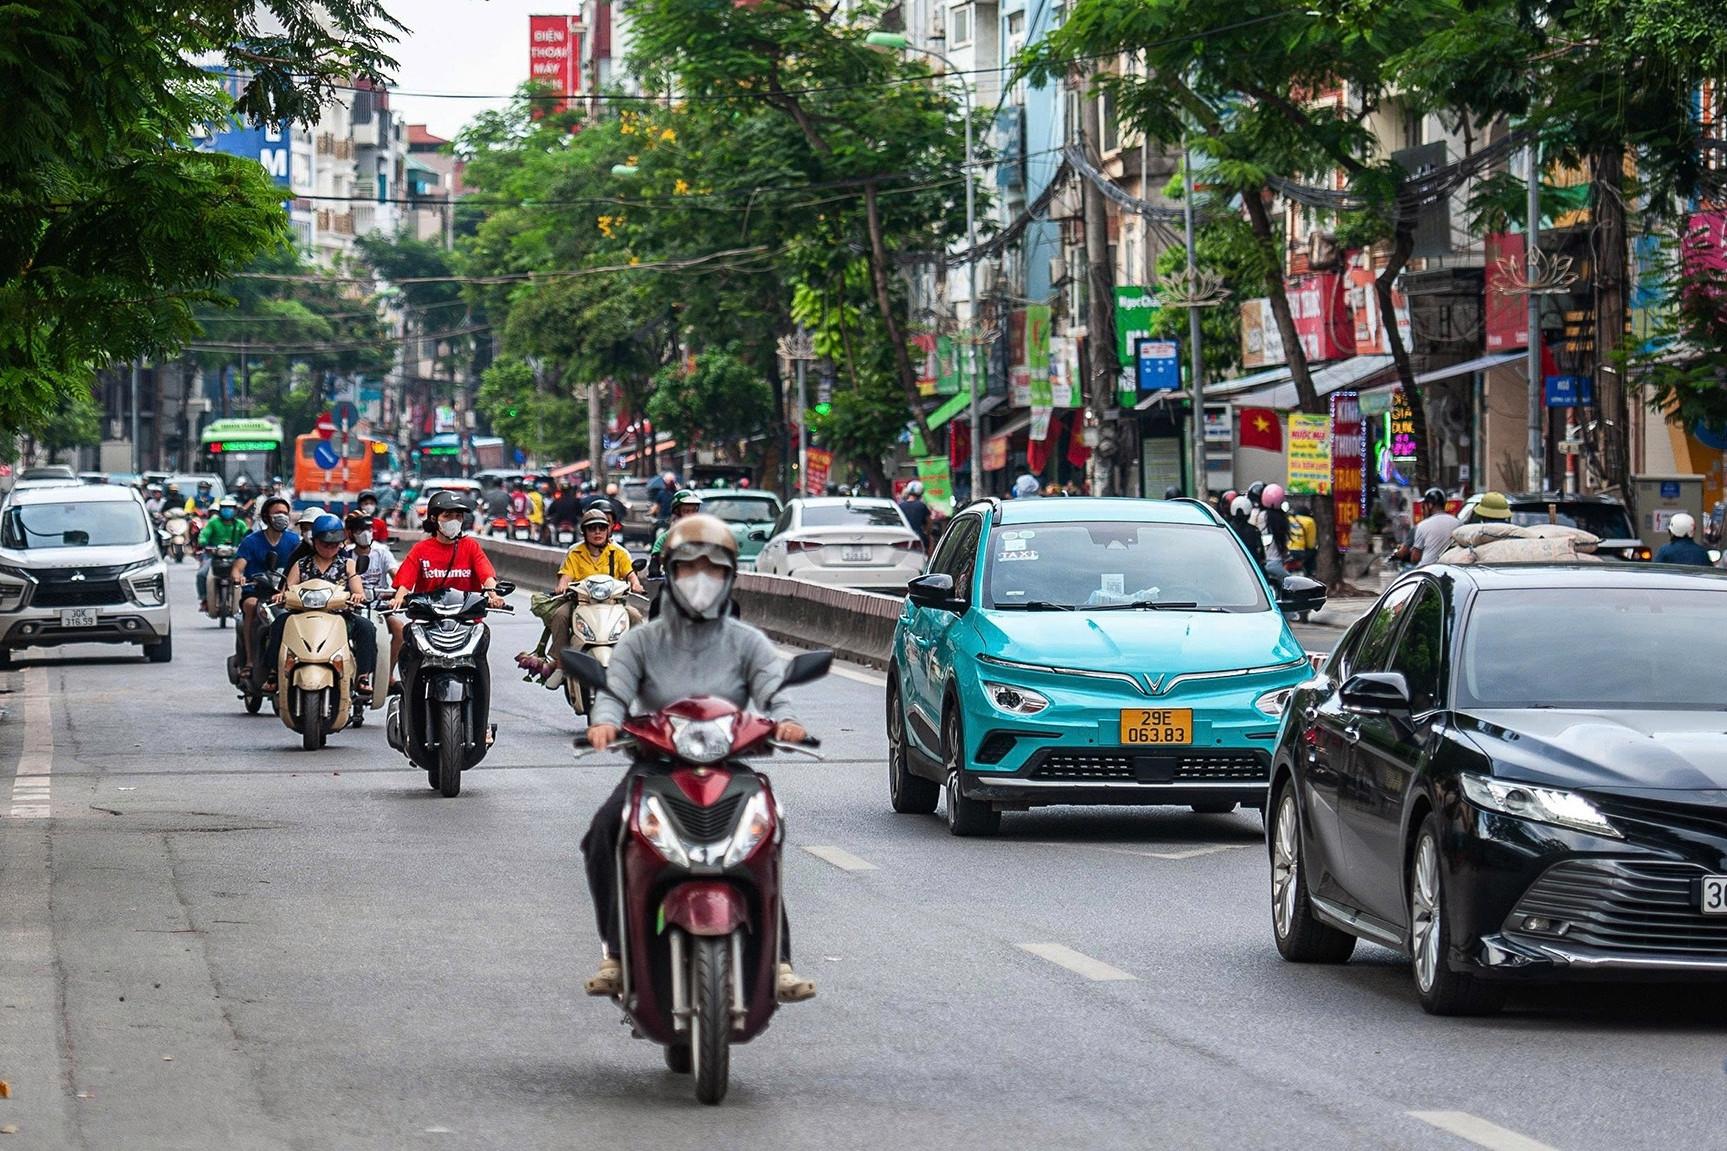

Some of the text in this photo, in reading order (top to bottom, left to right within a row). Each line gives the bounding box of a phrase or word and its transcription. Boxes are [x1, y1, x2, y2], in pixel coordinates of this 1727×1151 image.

[1141, 711, 1172, 725] 29E
[1129, 728, 1184, 742] 063.83
[1708, 882, 1727, 909] 3
